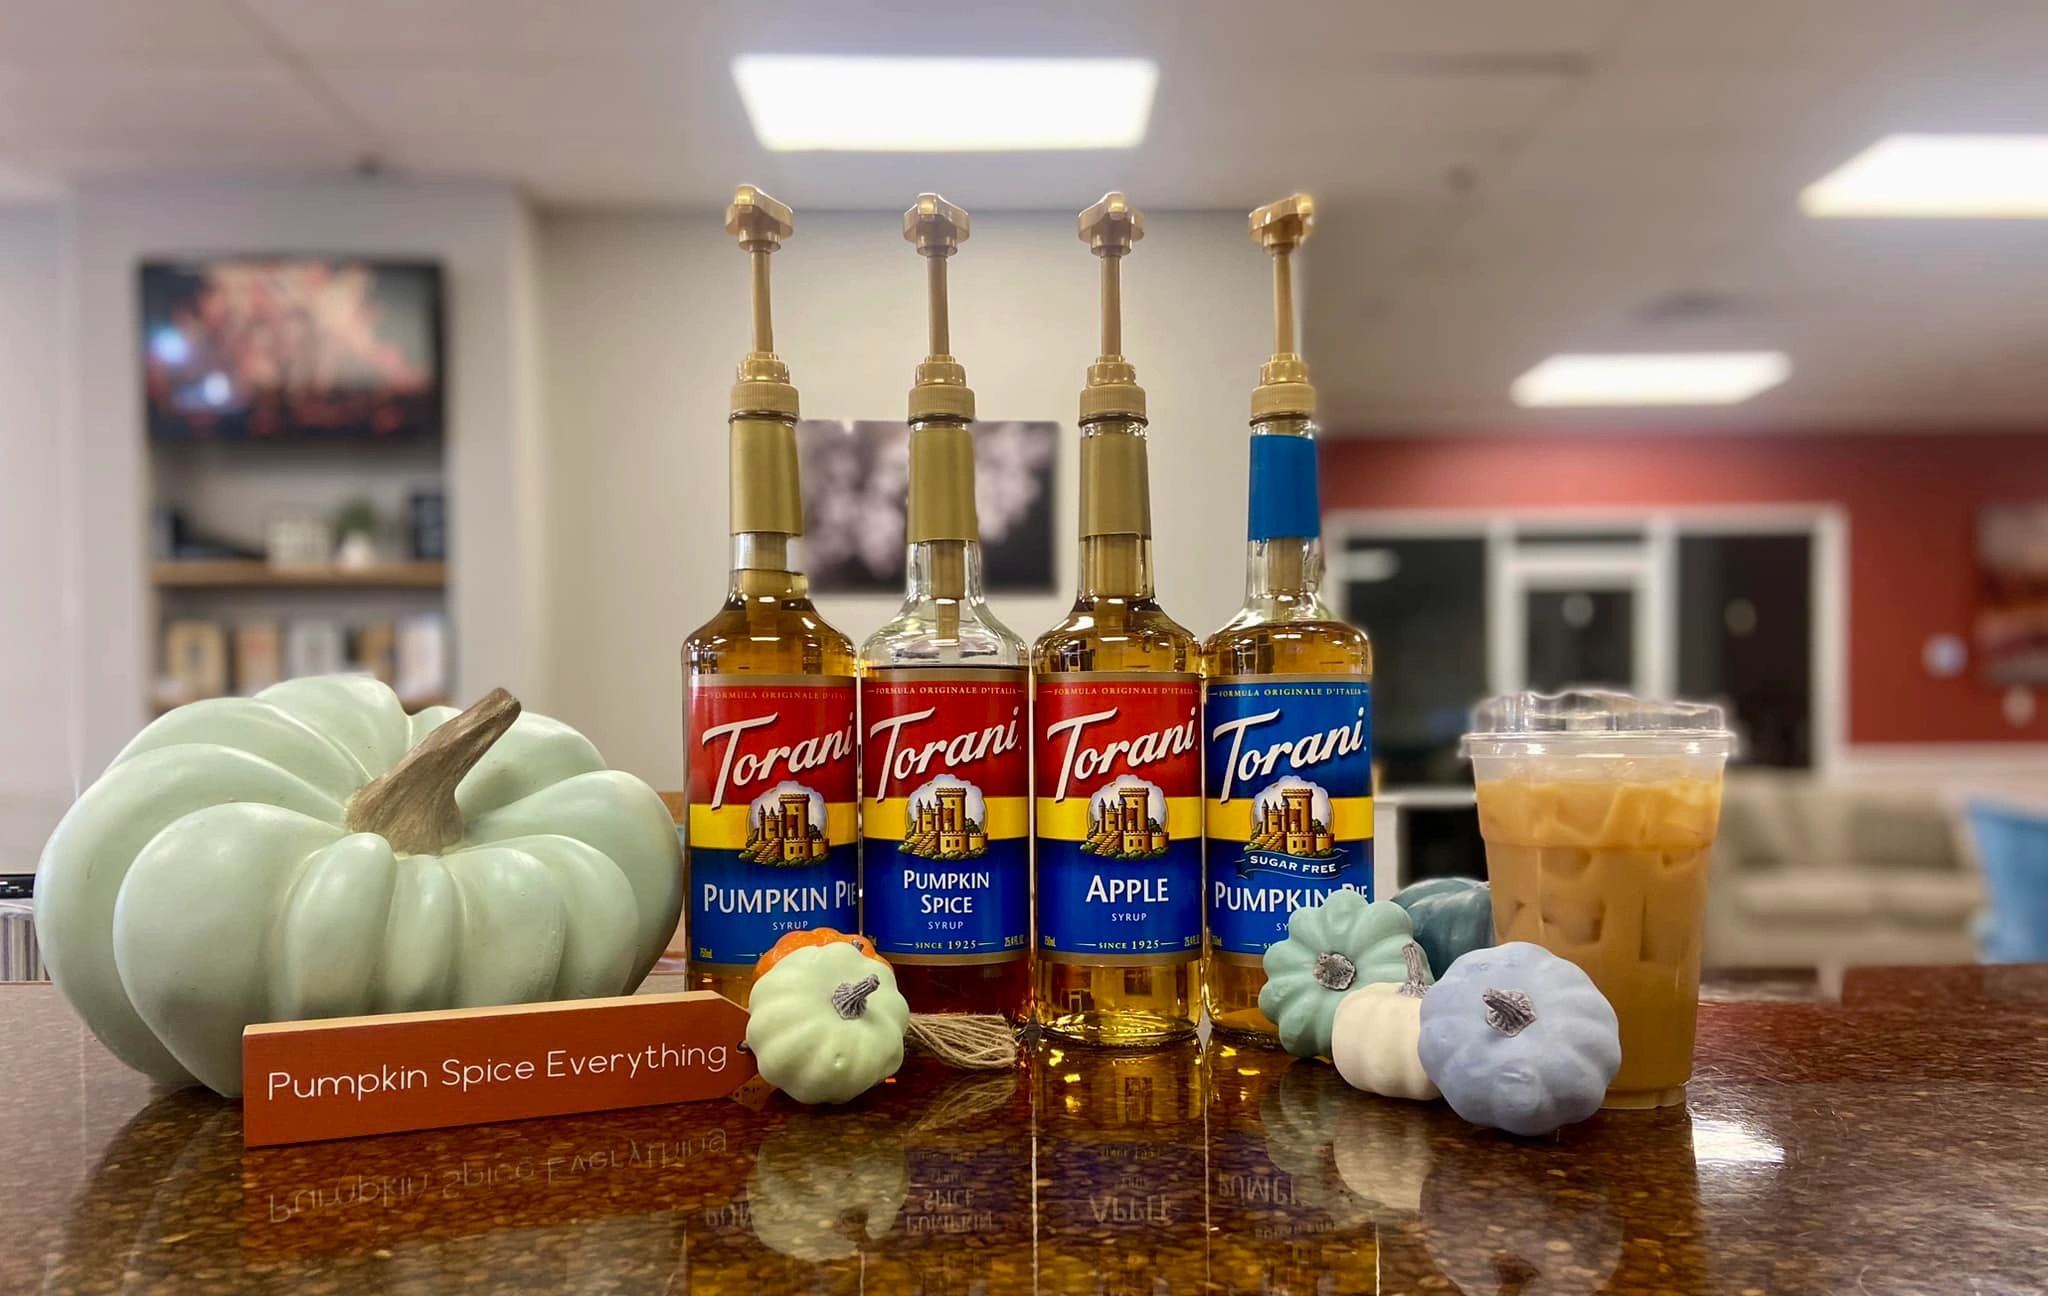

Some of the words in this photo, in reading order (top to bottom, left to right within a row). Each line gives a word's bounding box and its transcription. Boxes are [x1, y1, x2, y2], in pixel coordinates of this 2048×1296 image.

[711, 690, 757, 699] FORMULA
[761, 691, 818, 700] ORIGINALE
[876, 687, 916, 695] FORMULA
[919, 686, 978, 695] ORIGINALE
[981, 687, 1016, 695] D'ITALIA
[1054, 687, 1096, 695] FORMULA
[1101, 687, 1158, 695] ORIGINALE
[1161, 687, 1193, 695] D'ITALIA
[1219, 689, 1260, 697] FORMULA
[1263, 688, 1322, 696] ORIGINALE
[1326, 688, 1361, 696] D'ITALIA
[702, 711, 854, 811] Torani
[870, 706, 1020, 803] Torani
[1046, 706, 1197, 803] Torani
[1213, 707, 1366, 804] Torani
[1250, 855, 1298, 872] SUGAR
[1301, 861, 1337, 874] FREE
[903, 869, 990, 889] PUMPKIN
[1085, 874, 1169, 903] APPLE
[703, 883, 827, 914] PUMPKIN
[835, 880, 856, 907] PIE
[920, 894, 973, 914] SPICE
[1215, 882, 1332, 912] PUMPKIN
[772, 920, 809, 931] SYRUP
[927, 920, 964, 930] SYRUP
[1111, 912, 1147, 922] SYRUP
[915, 940, 943, 950] SINCE
[948, 939, 976, 950] 1925
[1098, 940, 1127, 950] SINCE
[1131, 939, 1160, 950] 1925
[268, 1064, 428, 1101] Pumpkin
[441, 1058, 536, 1093] Spice
[547, 1043, 728, 1080] Everything
